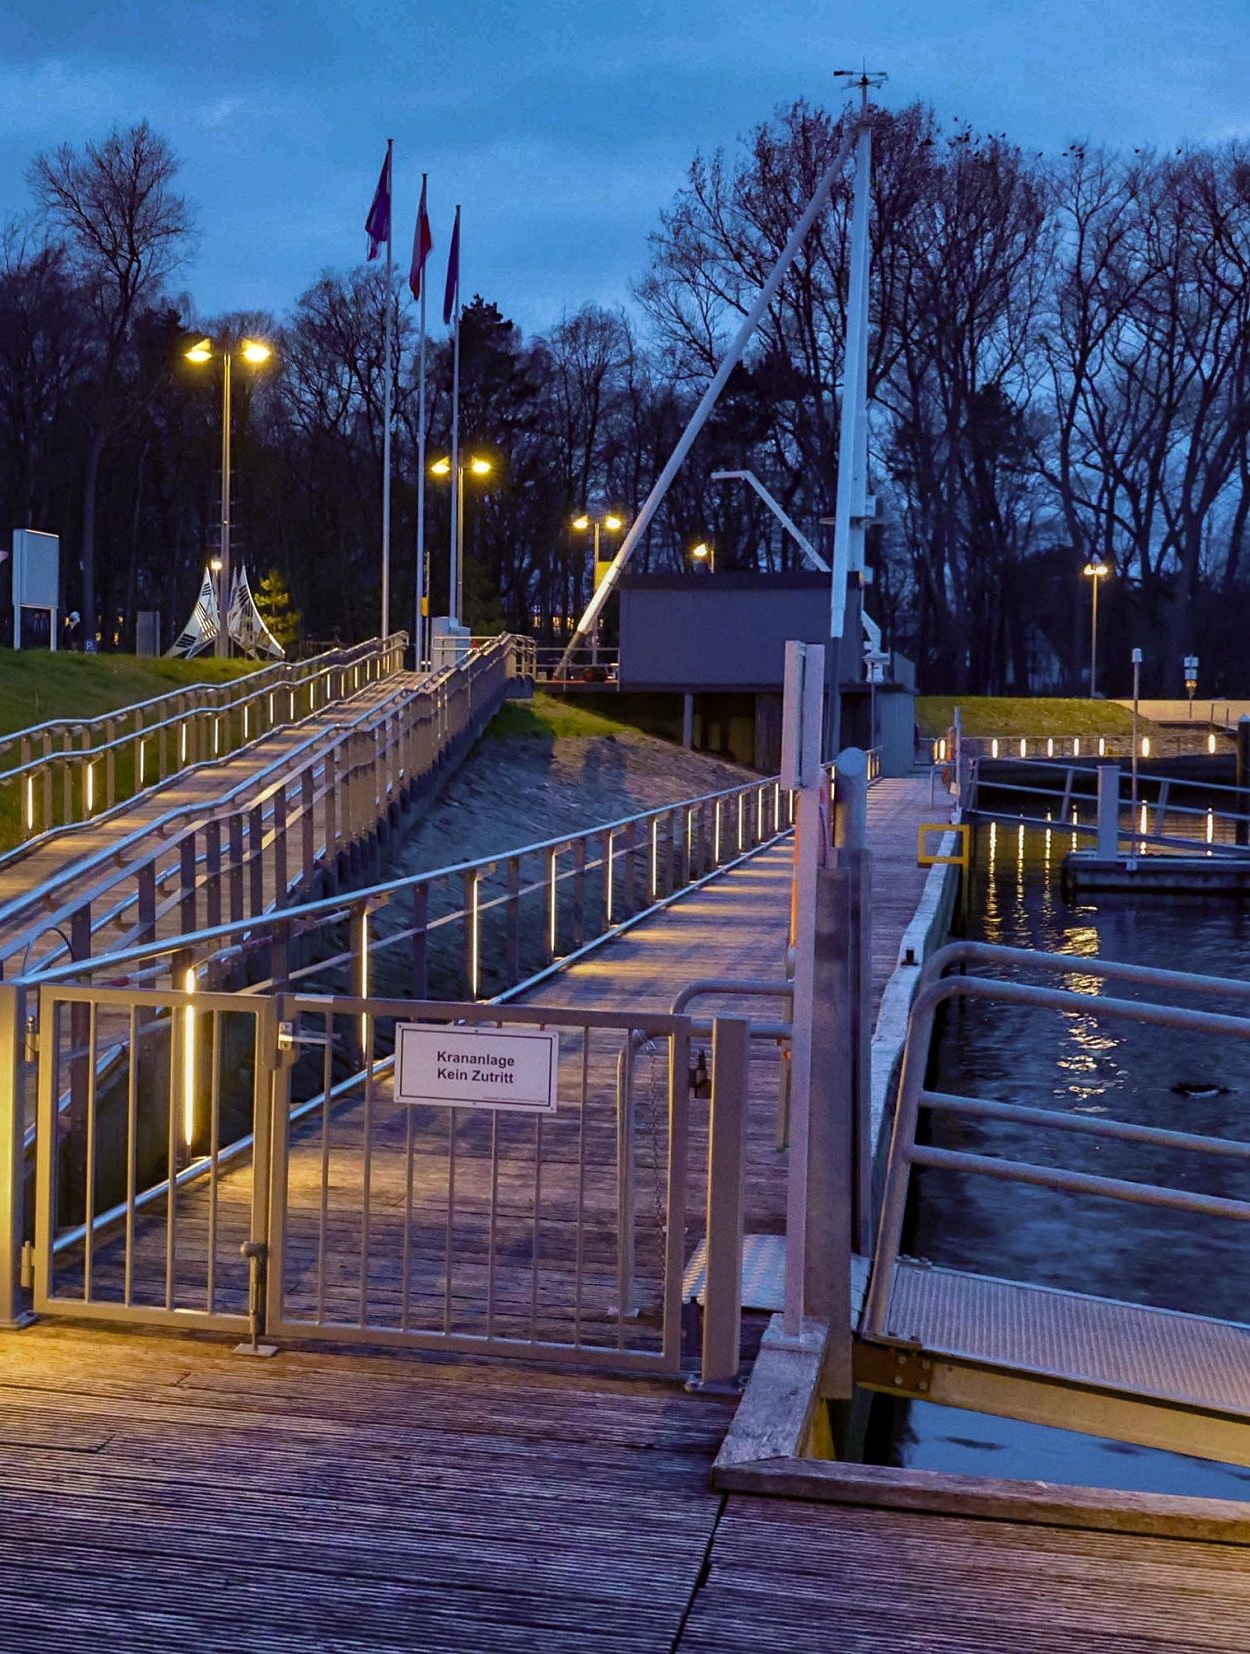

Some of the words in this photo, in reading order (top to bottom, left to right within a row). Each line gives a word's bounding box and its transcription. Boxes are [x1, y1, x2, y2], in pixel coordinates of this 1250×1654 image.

[437, 1050, 515, 1069] Krananlage
[437, 1068, 468, 1081] Kein
[471, 1070, 514, 1084] Zutritt
